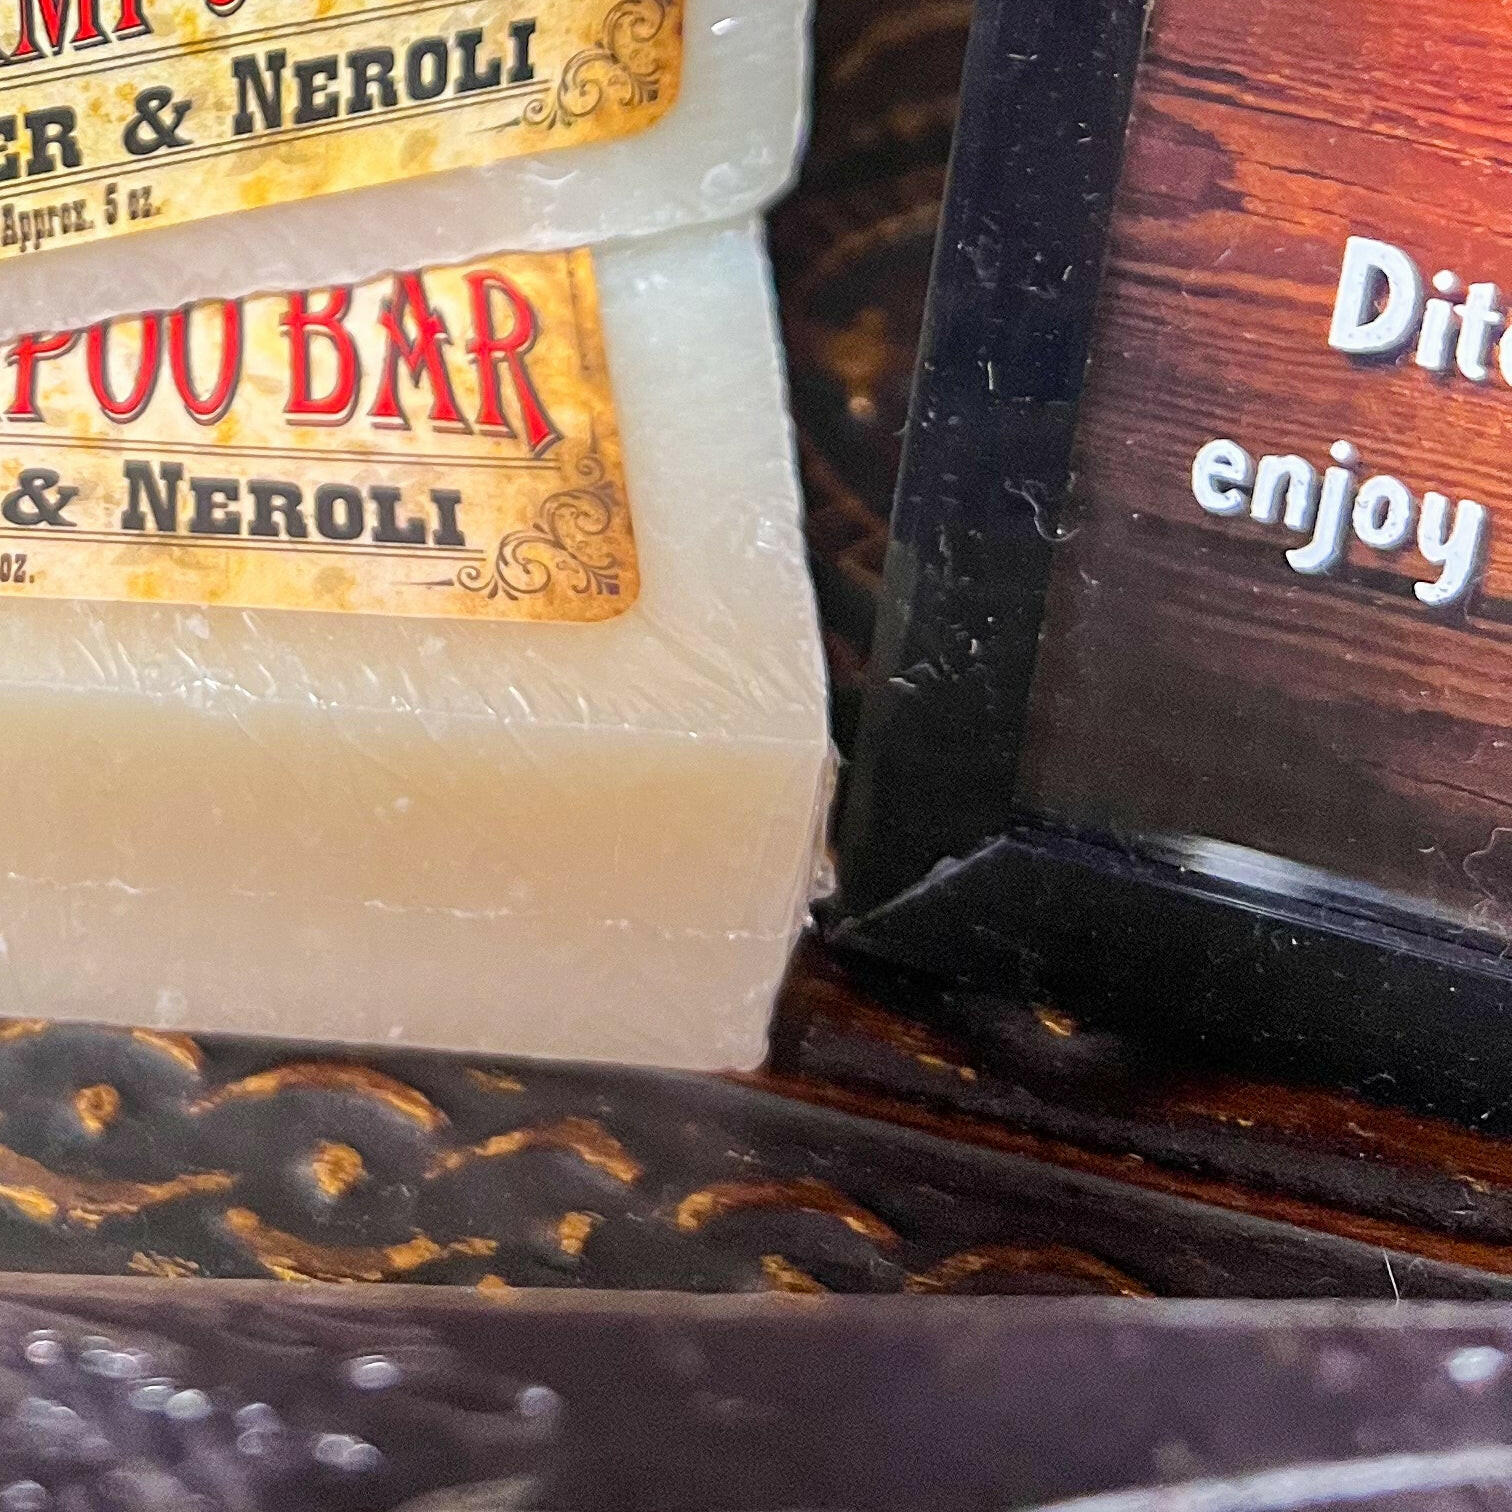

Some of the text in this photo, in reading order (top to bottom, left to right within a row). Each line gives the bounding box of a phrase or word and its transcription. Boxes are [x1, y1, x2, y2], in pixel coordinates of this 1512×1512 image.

[122, 85, 192, 156] &
[230, 19, 537, 137] NEROLI
[103, 182, 118, 225] 5
[279, 268, 562, 458] BAR
[0, 466, 80, 527] &
[120, 458, 468, 548] NEROLI
[1191, 438, 1485, 607] enjoy
[0, 552, 35, 584] oz.
